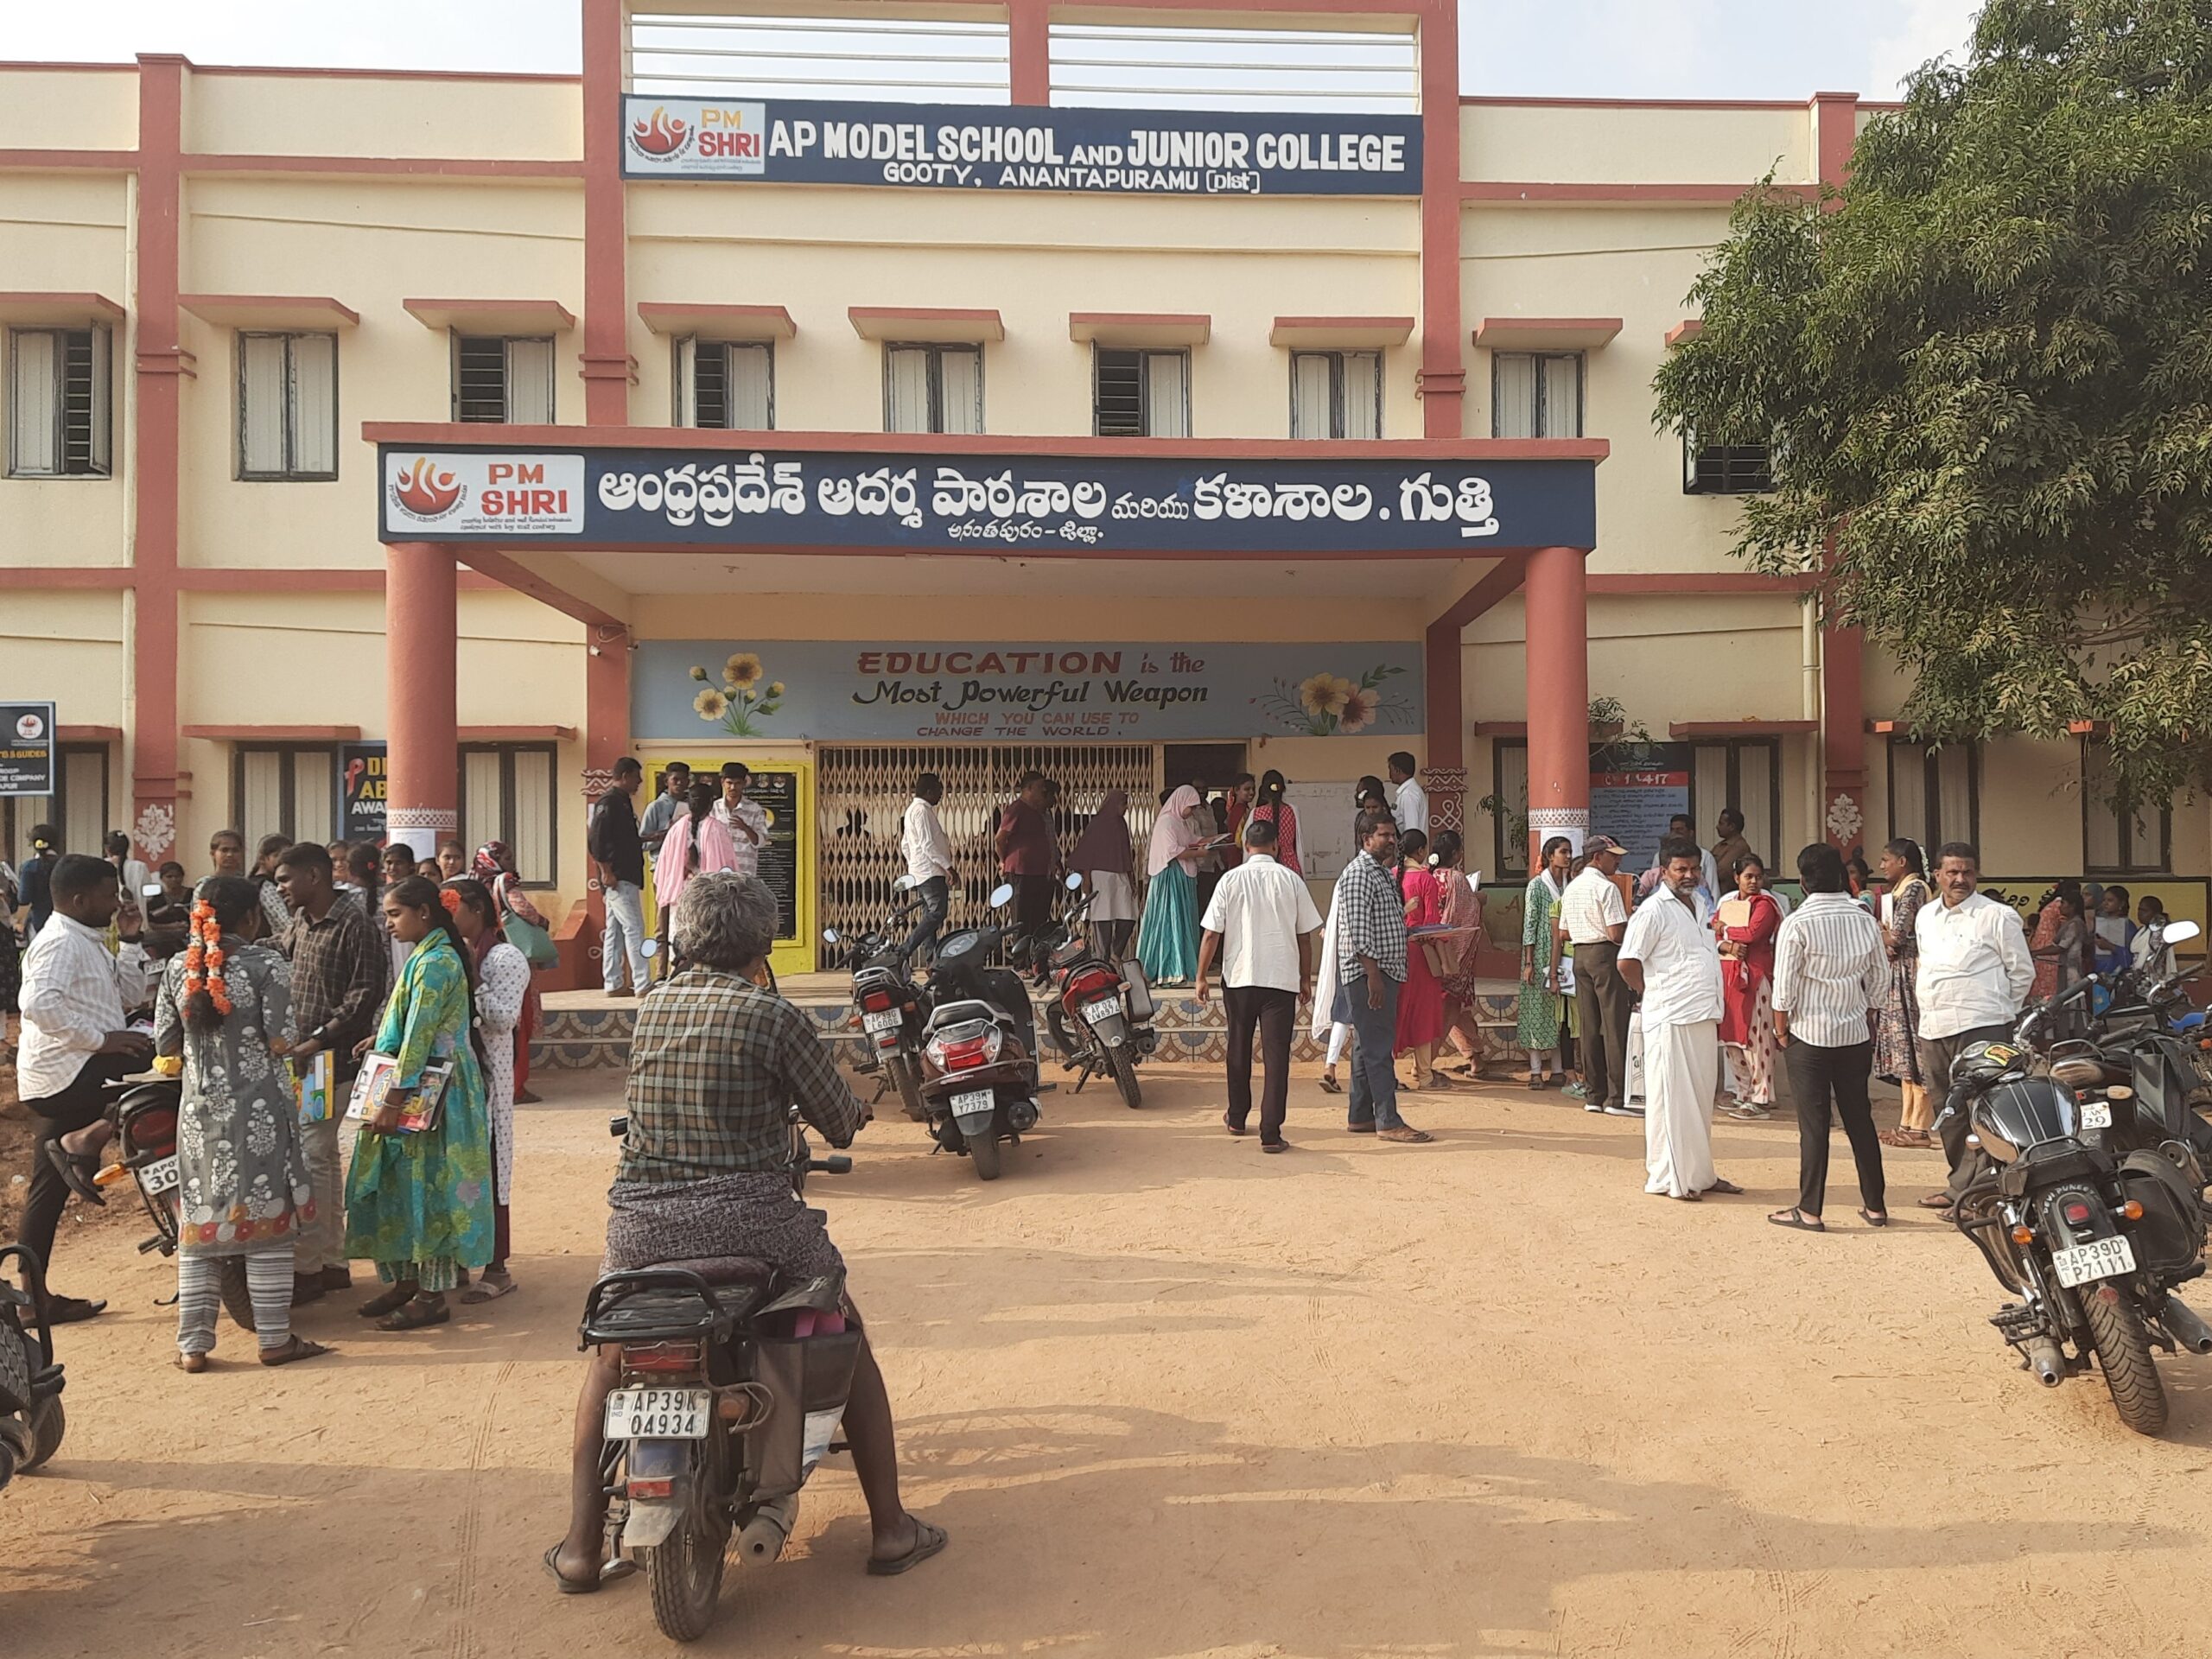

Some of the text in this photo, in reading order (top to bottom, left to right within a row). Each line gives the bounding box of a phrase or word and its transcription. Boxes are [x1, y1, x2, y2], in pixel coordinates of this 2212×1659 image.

[701, 109, 742, 130] PM
[698, 131, 760, 157] SHRI
[768, 120, 1406, 172] AP MODEL SCHOOL AND JUNIOR COLLEGE
[883, 162, 982, 188] GOOTY,
[998, 166, 1198, 191] ANANTAPURAMU
[488, 463, 544, 485] PM
[480, 490, 568, 516] SHRI
[817, 467, 923, 529] ఆదర్శ
[856, 652, 1205, 674] EDUCATION is the
[852, 679, 942, 704] Most
[1103, 679, 1209, 711] Weapon
[935, 711, 1140, 725] WHICH YOU CAN USE TO
[917, 727, 984, 737] CHANGE
[994, 727, 1028, 736] THE
[958, 1091, 988, 1104] AP39M
[958, 1100, 988, 1114] Y7379
[2069, 1239, 2122, 1267] AP39D
[2072, 1255, 2127, 1282] P7111
[632, 1391, 697, 1412] AP39K
